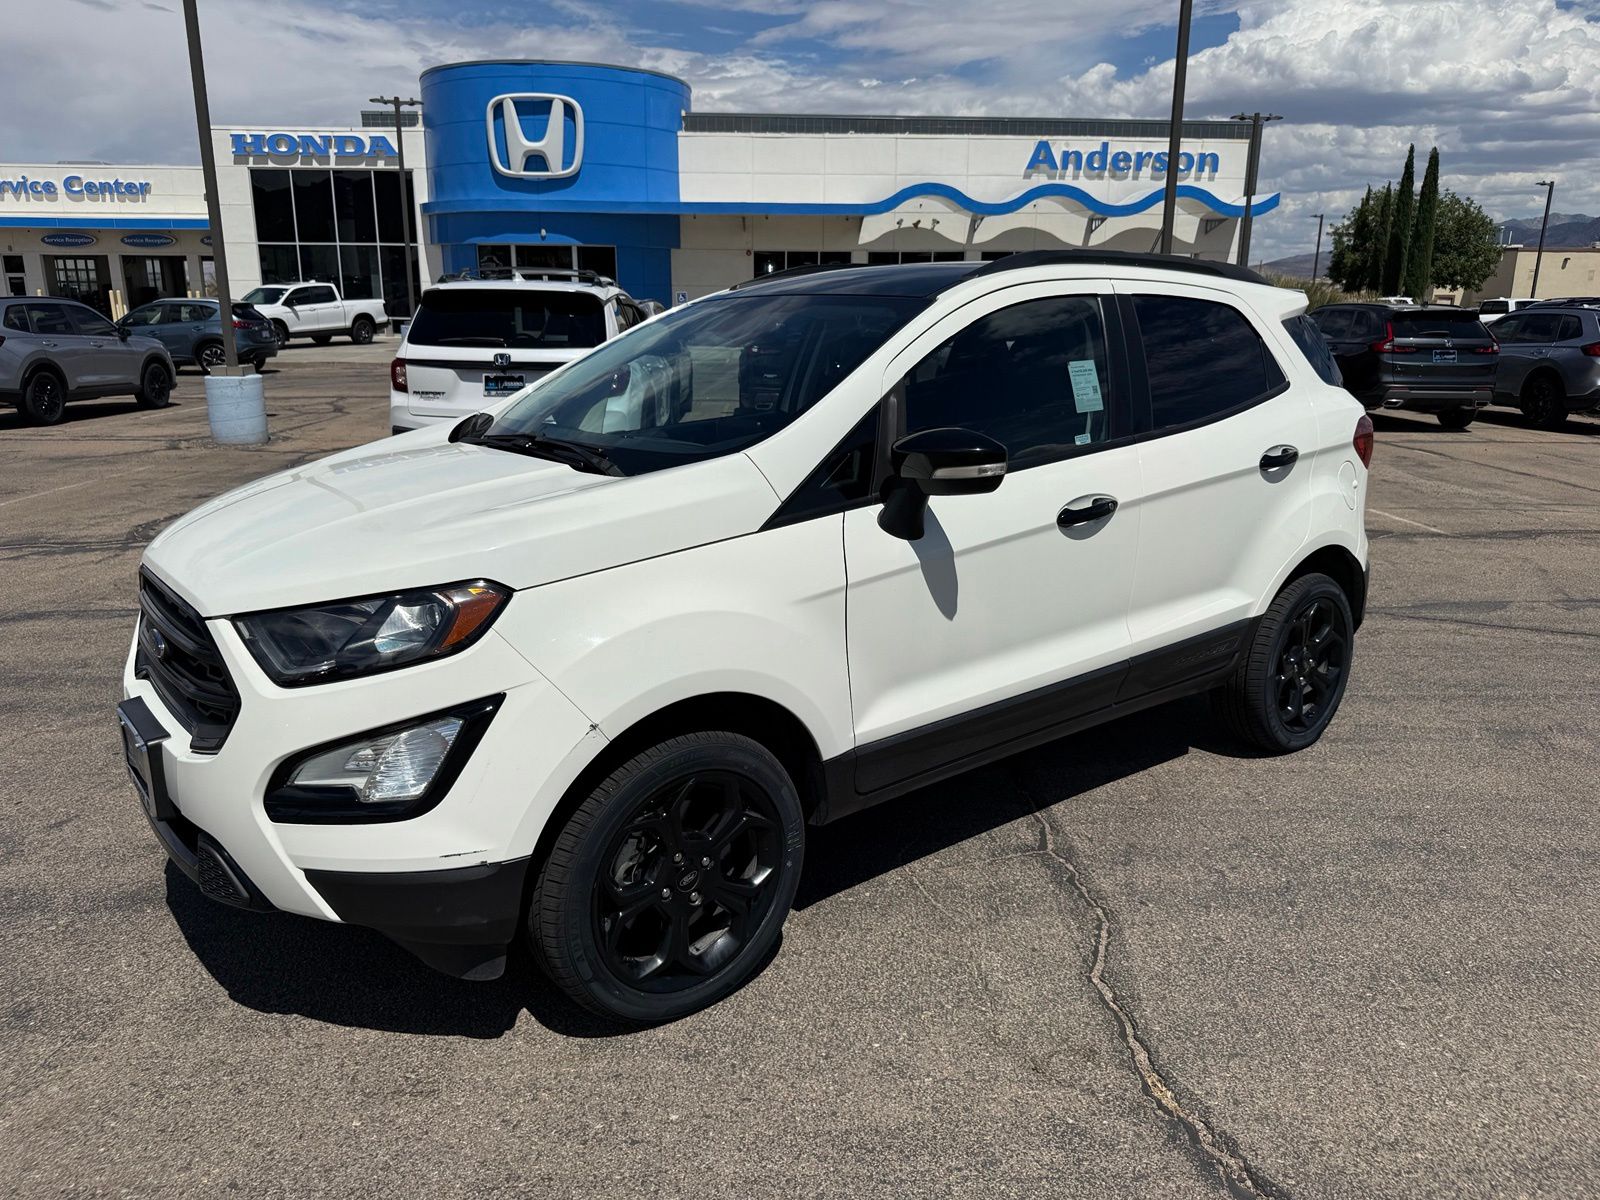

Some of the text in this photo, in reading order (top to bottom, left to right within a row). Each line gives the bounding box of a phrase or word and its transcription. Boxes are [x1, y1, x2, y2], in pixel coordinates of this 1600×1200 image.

[230, 133, 399, 157] HONDA
[1026, 140, 1220, 173] Anderson
[63, 175, 151, 196] Center
